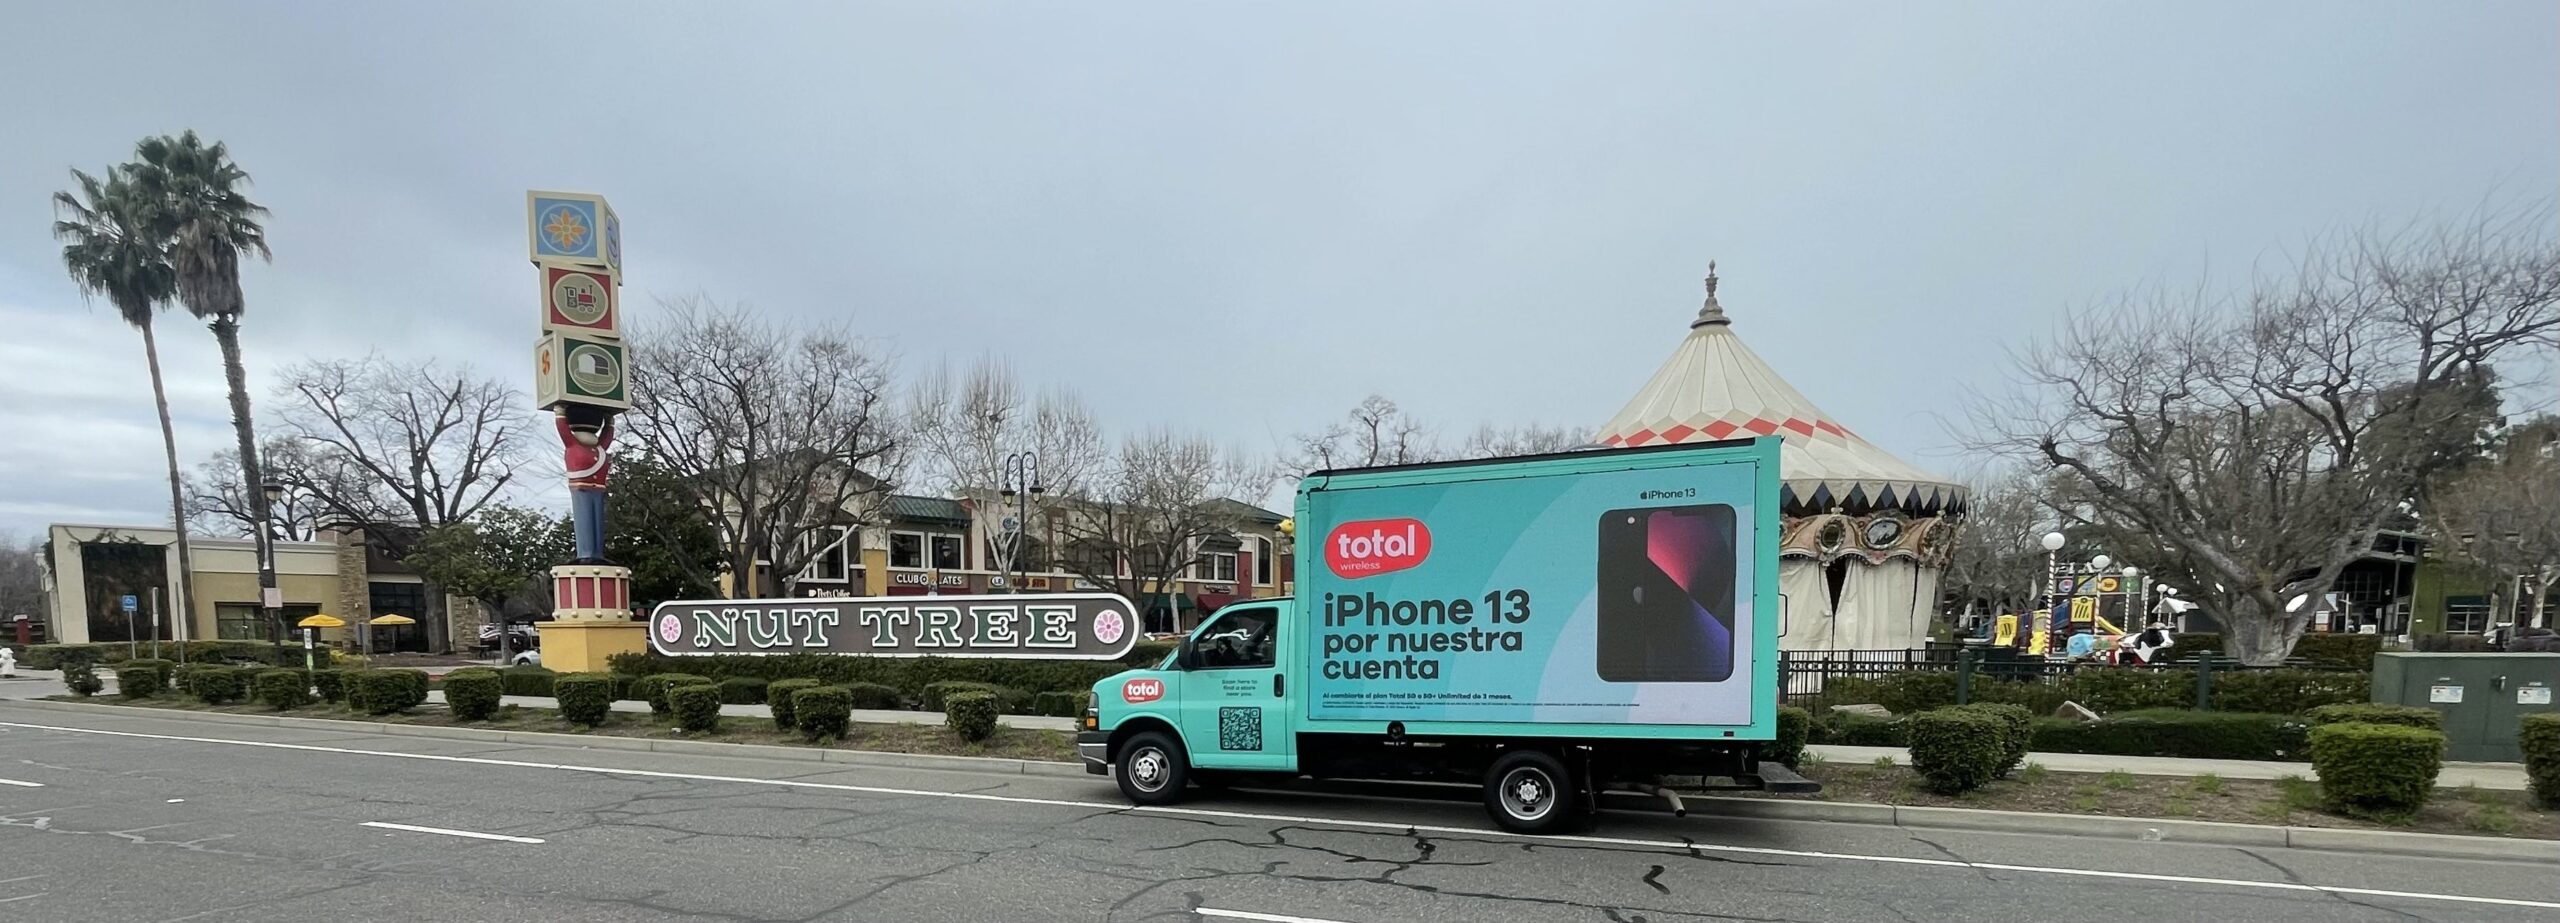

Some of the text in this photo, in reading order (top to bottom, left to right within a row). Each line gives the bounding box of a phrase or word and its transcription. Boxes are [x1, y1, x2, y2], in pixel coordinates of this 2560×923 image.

[1647, 487, 1696, 499] iPhone 13
[1338, 524, 1415, 559] total
[1340, 560, 1381, 571] wireless
[896, 573, 919, 584] CLUB
[1324, 588, 1531, 627] iPhone 13
[692, 604, 1078, 649] NUT TREE
[1324, 627, 1523, 659] por nuestra
[1322, 655, 1439, 680] cuenta
[1128, 681, 1159, 696] total
